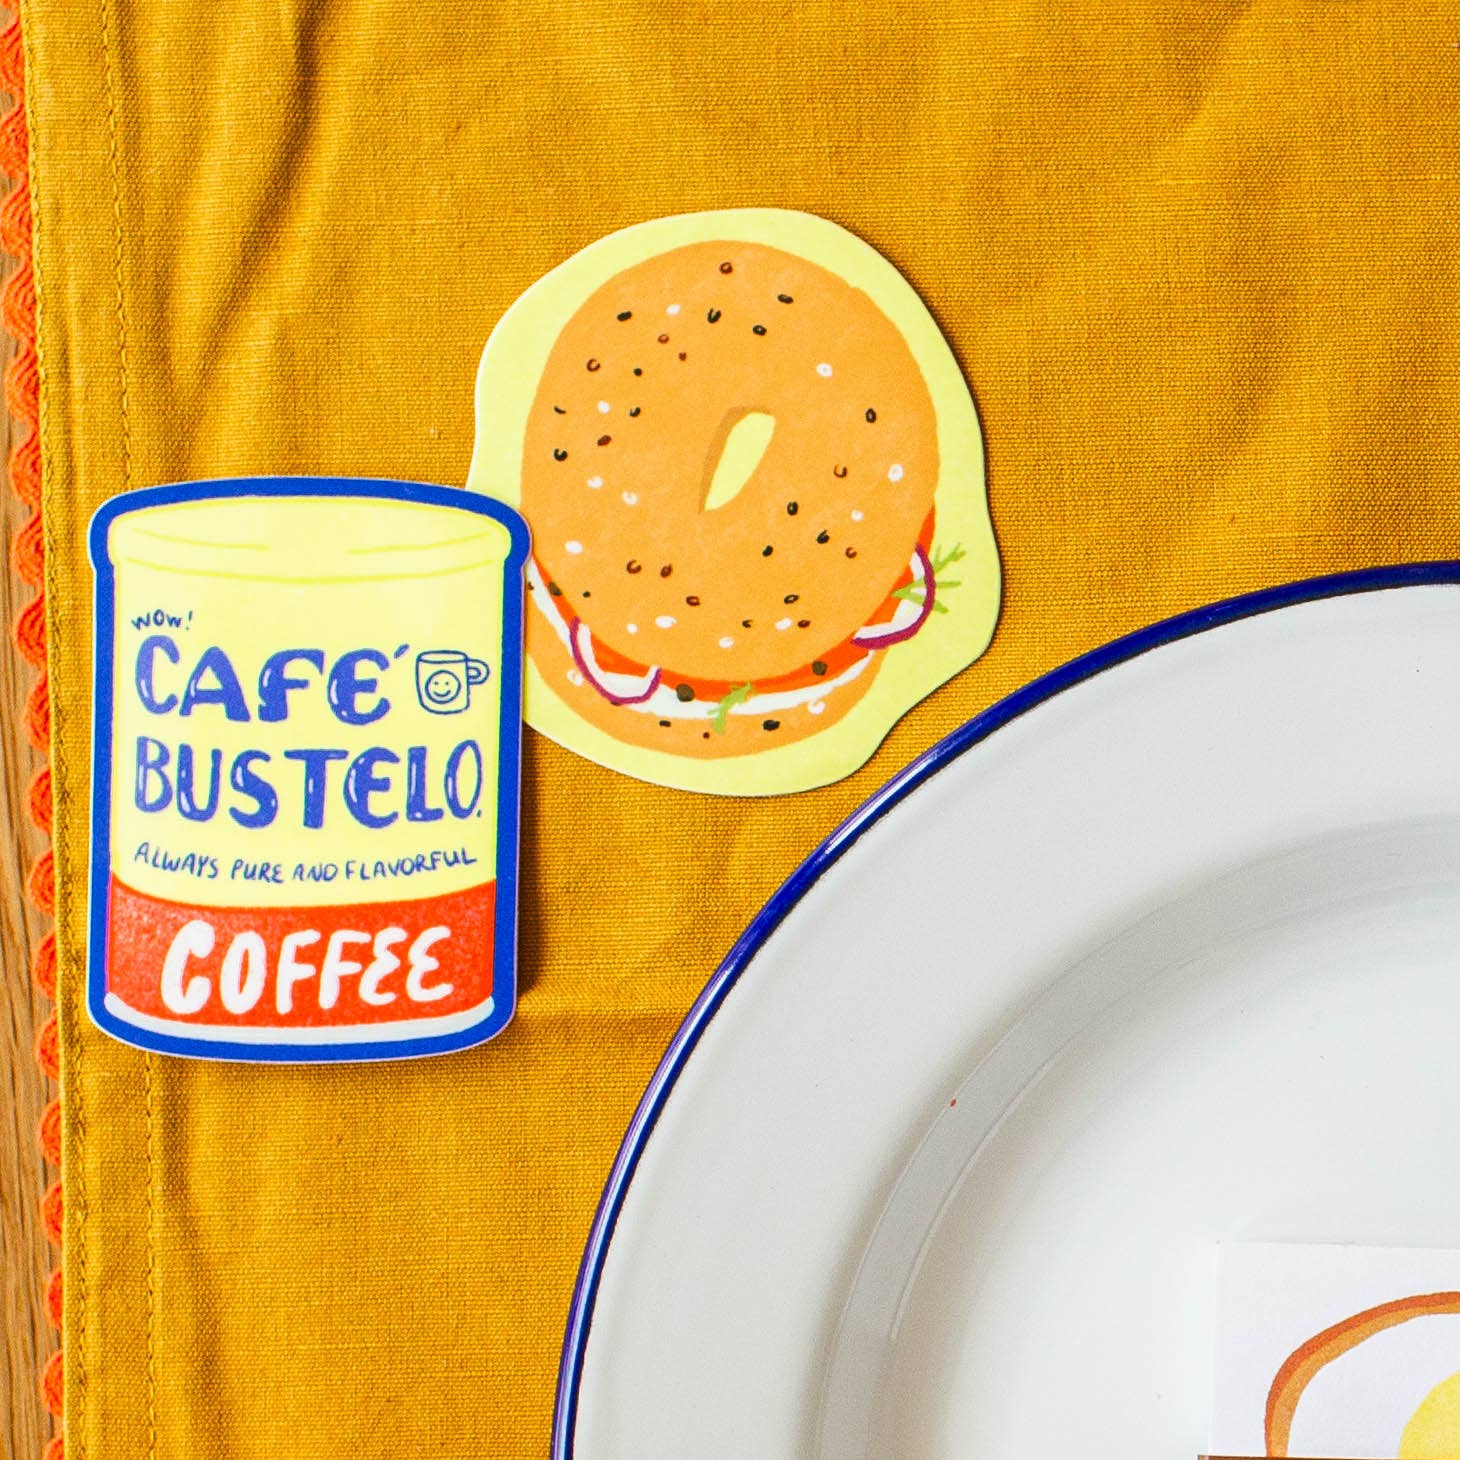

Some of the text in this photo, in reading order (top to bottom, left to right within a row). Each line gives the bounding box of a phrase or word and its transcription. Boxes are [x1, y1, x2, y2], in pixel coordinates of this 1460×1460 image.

[134, 842, 477, 884] ALWAYS PURE AND FLAVORFUL
[160, 919, 454, 1016] COFFEE
